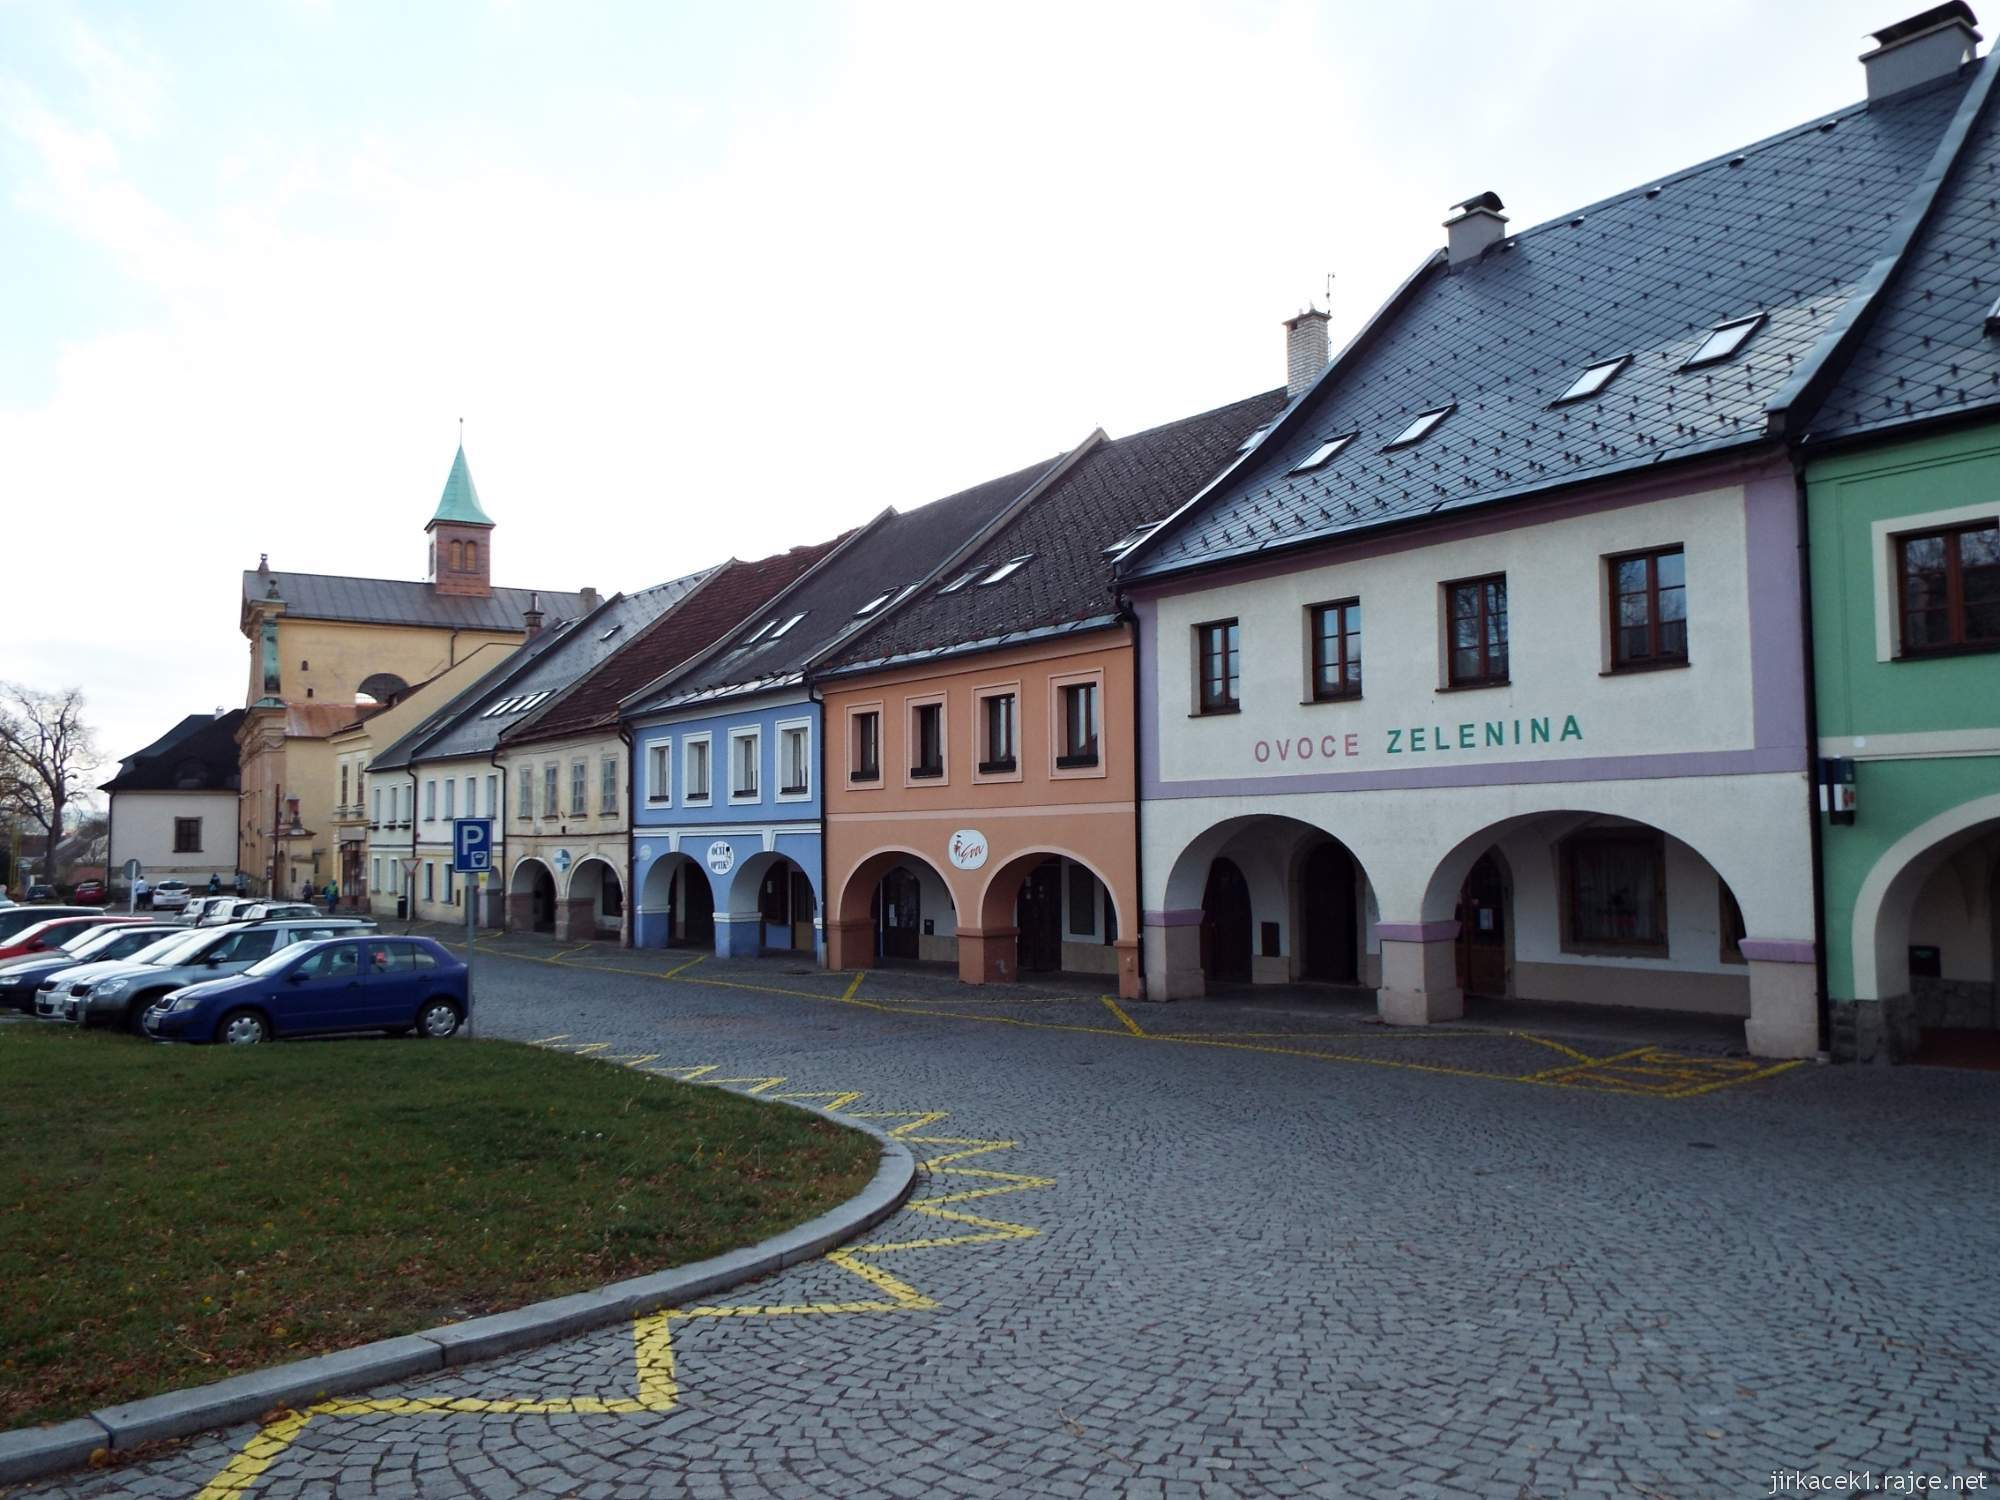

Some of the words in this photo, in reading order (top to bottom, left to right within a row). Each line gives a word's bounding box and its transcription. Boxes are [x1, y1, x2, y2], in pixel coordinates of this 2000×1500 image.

[1254, 733, 1359, 763] OVOCE
[1386, 714, 1583, 754] ZELENINA
[462, 825, 484, 856] P
